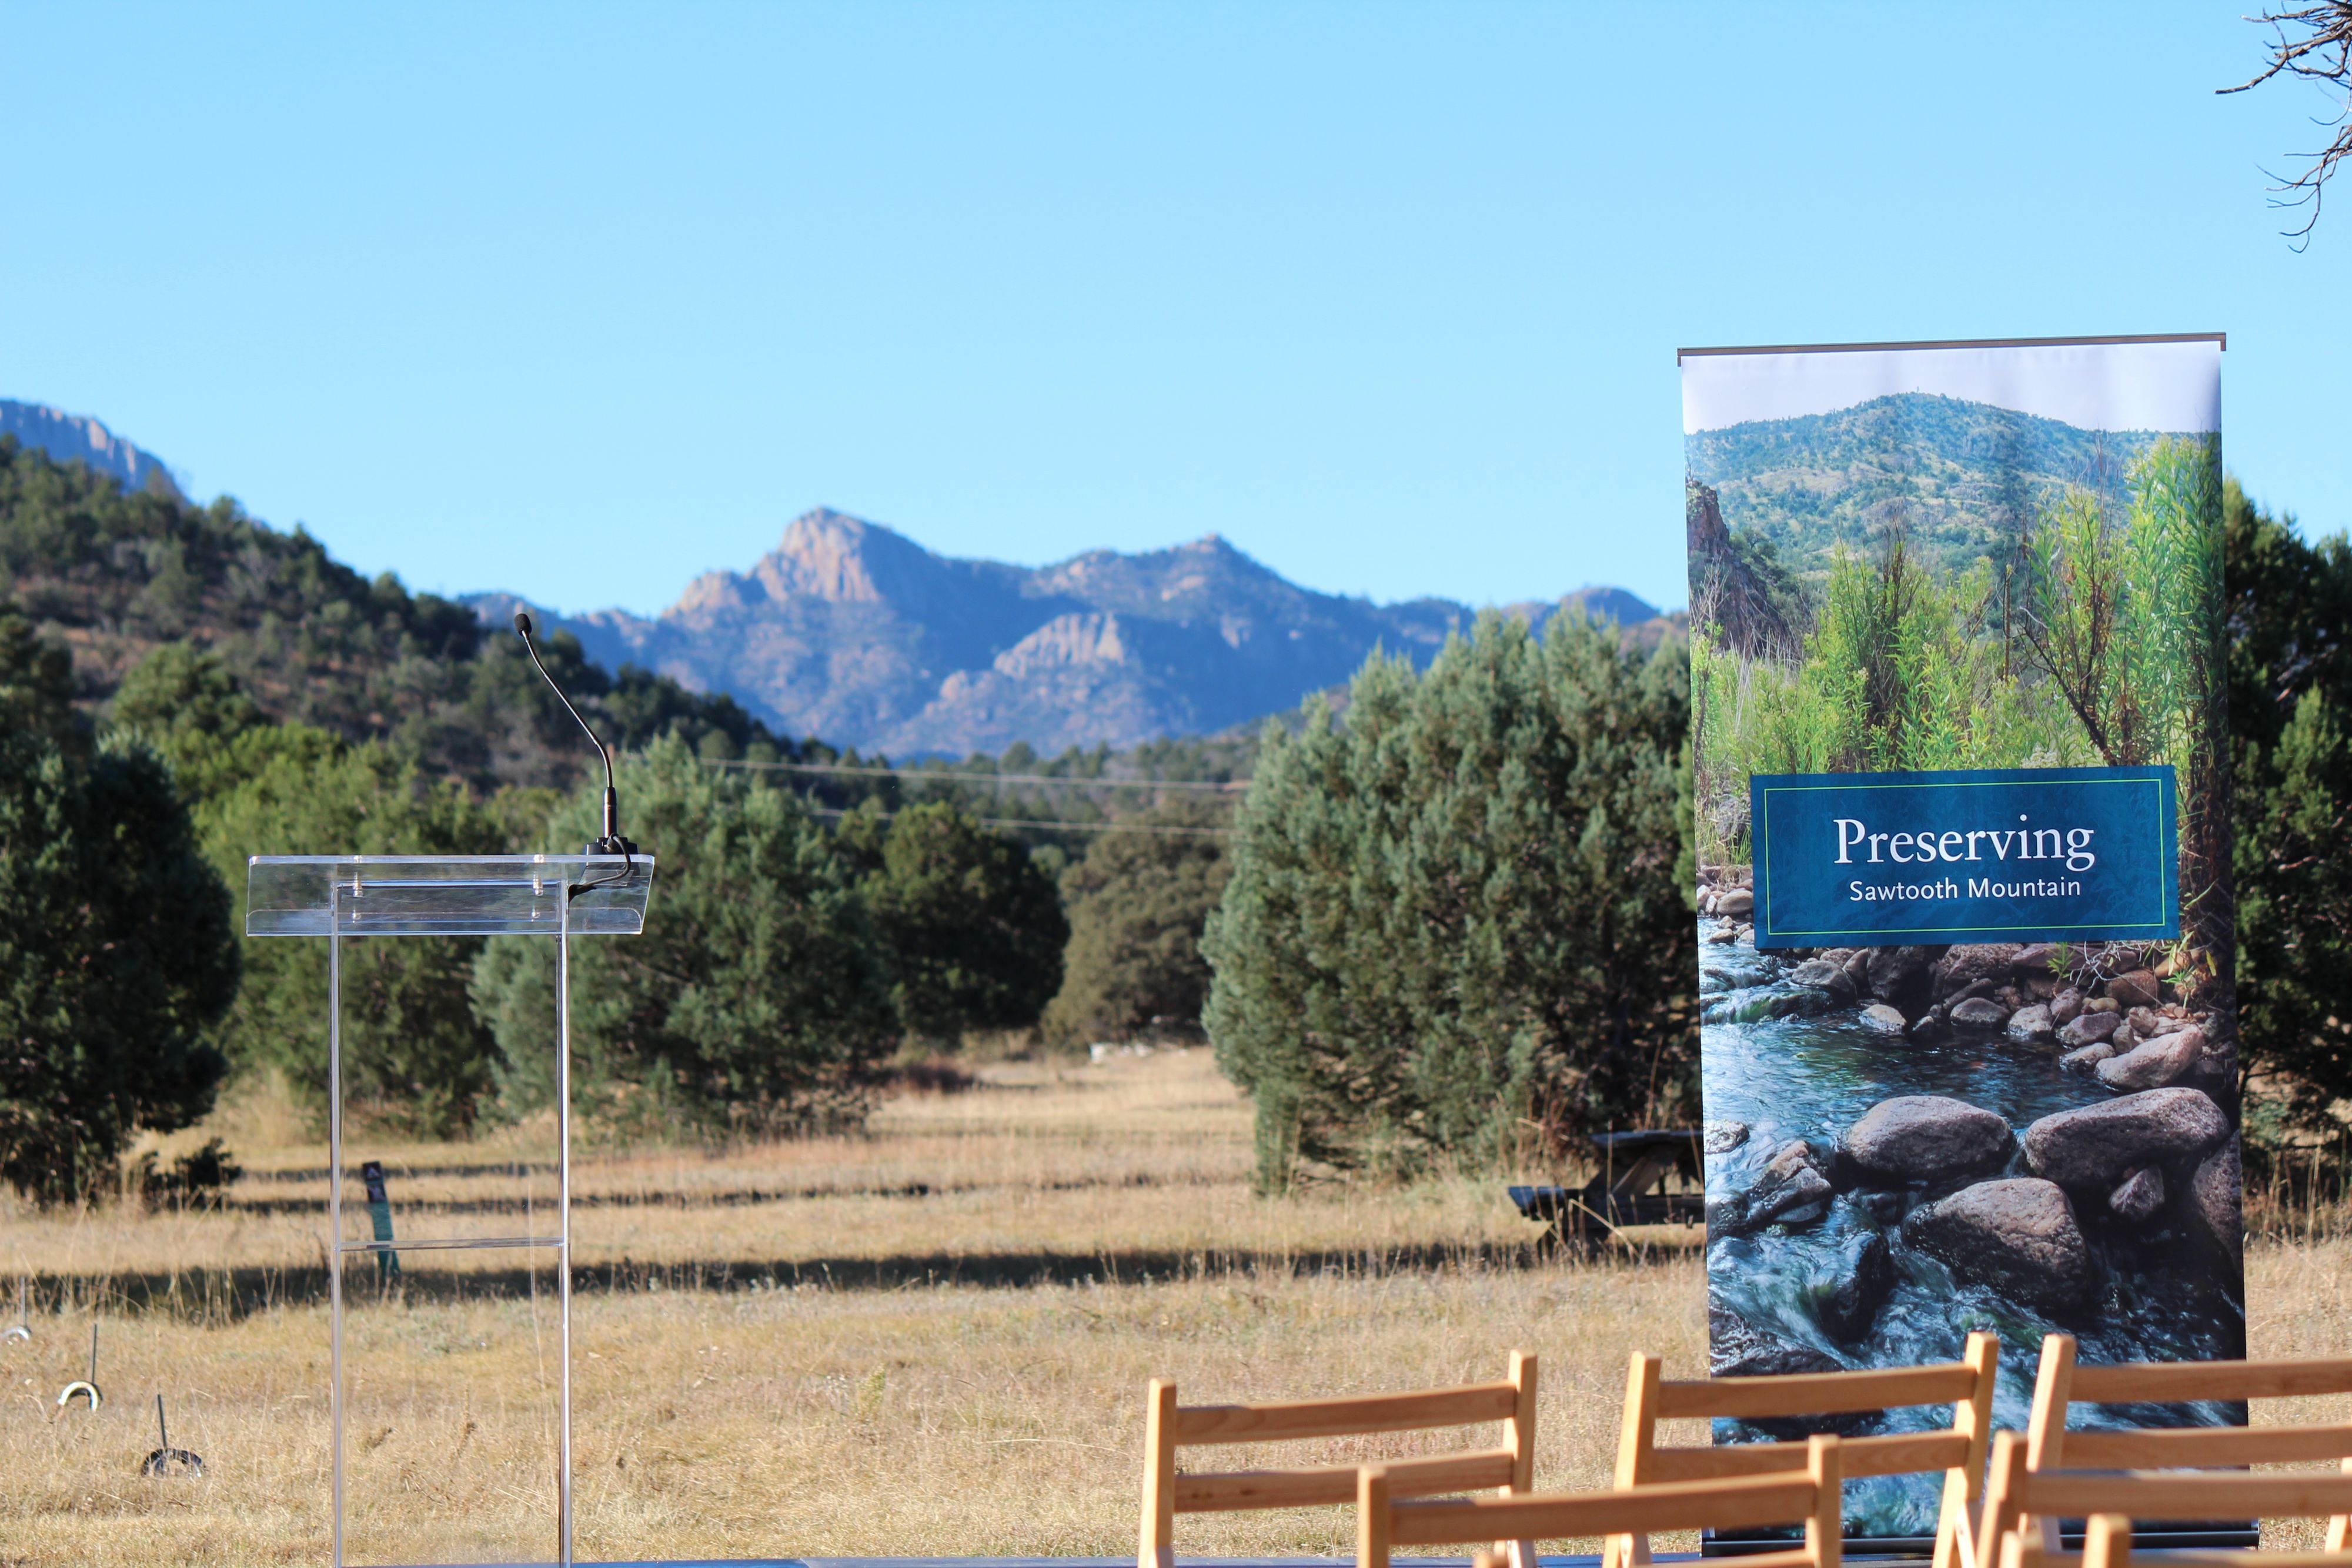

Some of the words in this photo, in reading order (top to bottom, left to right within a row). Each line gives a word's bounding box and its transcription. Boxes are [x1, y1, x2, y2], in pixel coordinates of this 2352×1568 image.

[1833, 814, 2095, 871] Preserving
[1850, 877, 1958, 901] Sawtooth
[1968, 876, 2081, 898] Mountain
